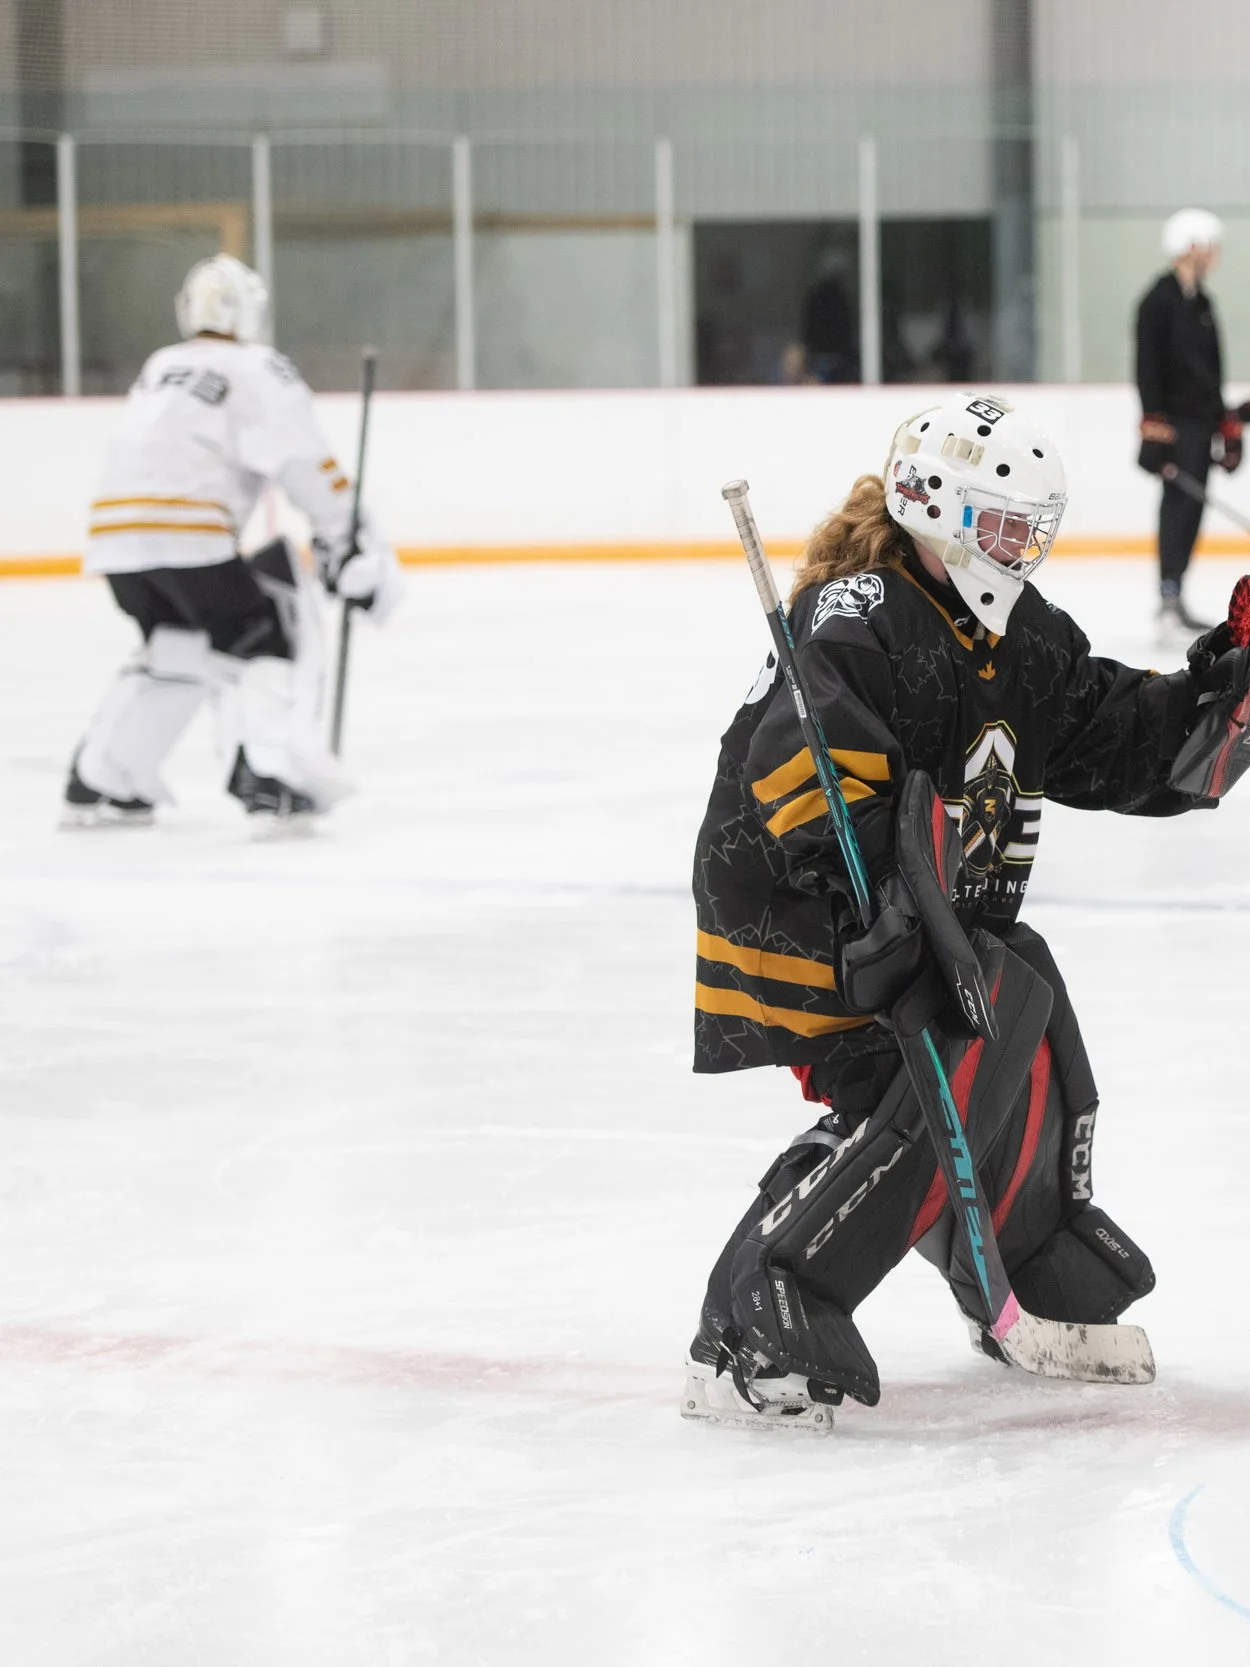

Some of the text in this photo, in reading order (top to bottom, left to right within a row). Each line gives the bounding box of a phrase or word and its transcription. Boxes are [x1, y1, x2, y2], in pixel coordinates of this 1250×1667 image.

[968, 400, 1003, 421] 33
[758, 1117, 871, 1236] CCM
[1071, 1110, 1096, 1200] CCM
[802, 1146, 904, 1260] CCM
[751, 1290, 763, 1311] 28+1
